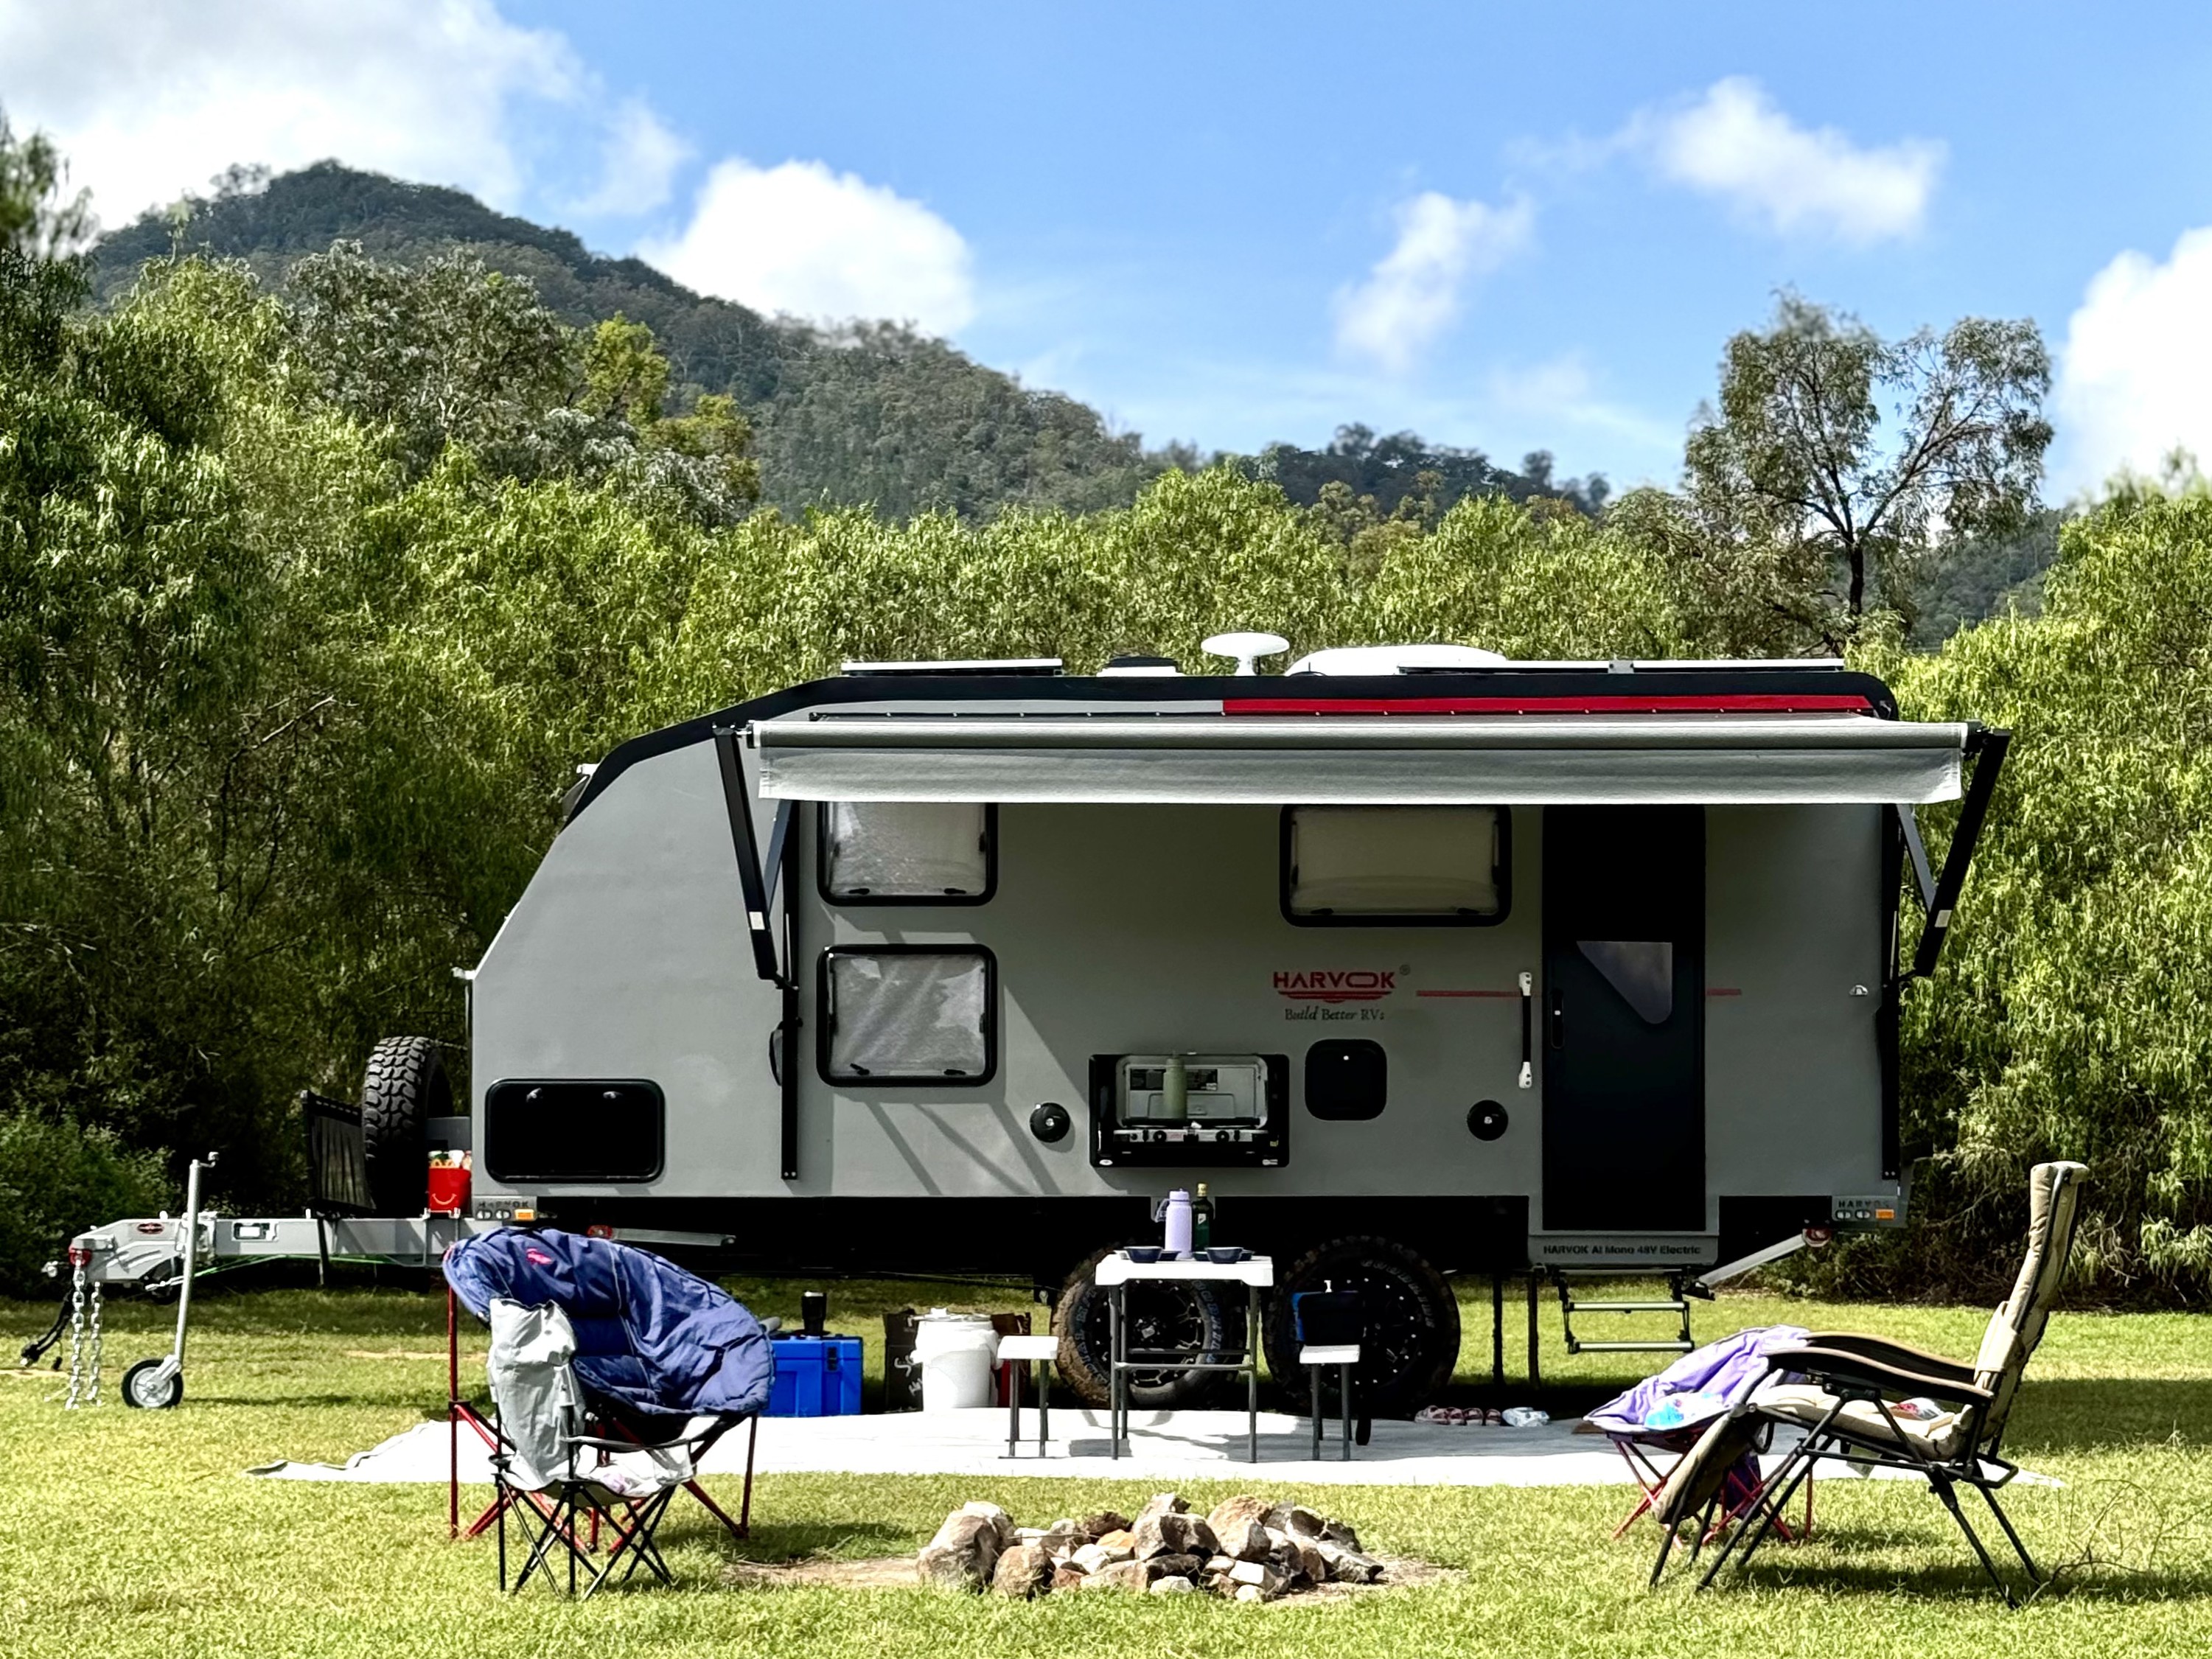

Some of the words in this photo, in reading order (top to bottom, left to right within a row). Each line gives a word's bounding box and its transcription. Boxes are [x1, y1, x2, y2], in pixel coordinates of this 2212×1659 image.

[1273, 971, 1395, 988] HARVOK
[1285, 1005, 1319, 1021] Build
[1322, 1008, 1357, 1021] Better
[1361, 1008, 1384, 1021] RVs
[1543, 1246, 1588, 1254] HARVOK
[1605, 1246, 1635, 1254] Mono
[1637, 1246, 1659, 1254] 48V
[1660, 1246, 1702, 1254] Electric
